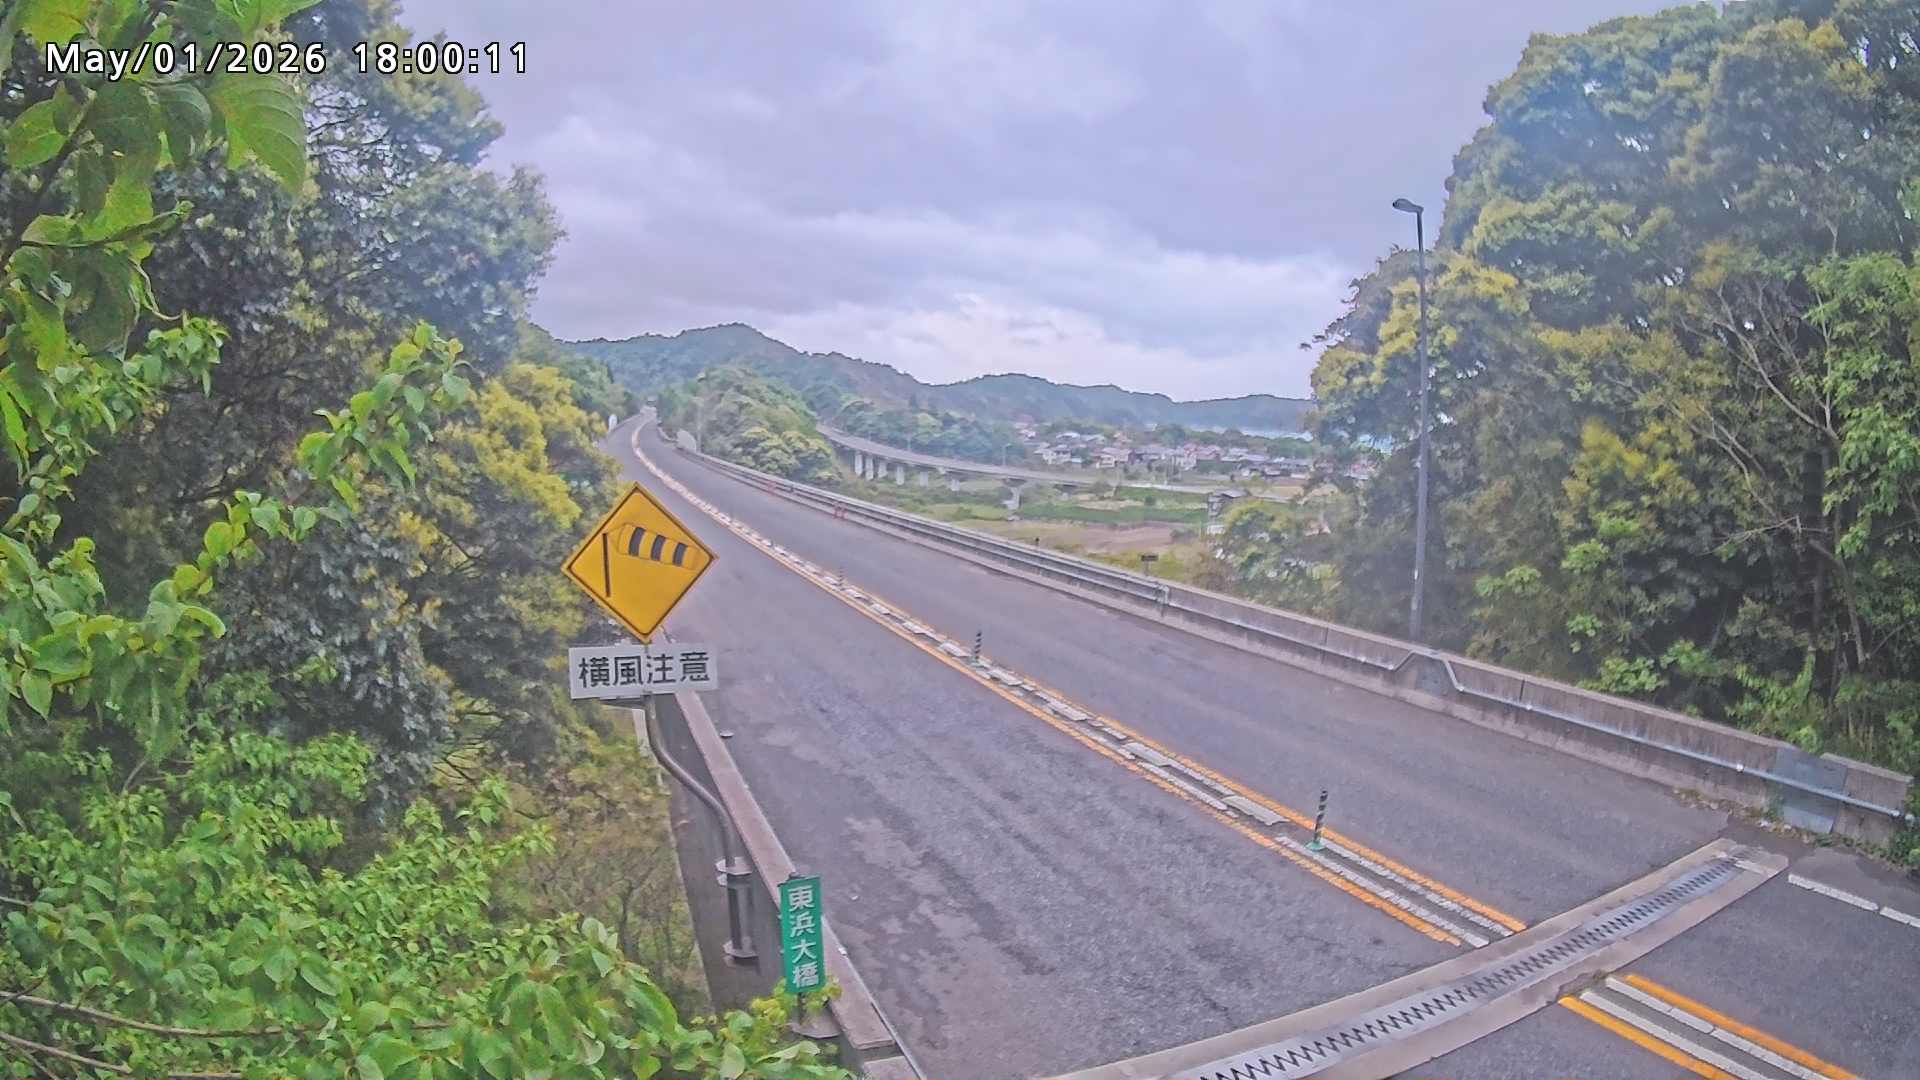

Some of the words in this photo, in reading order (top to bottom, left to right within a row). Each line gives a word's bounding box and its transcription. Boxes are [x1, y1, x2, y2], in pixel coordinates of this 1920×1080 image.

[578, 651, 711, 688] 横風注意
[788, 885, 819, 988] 東浜大橋
